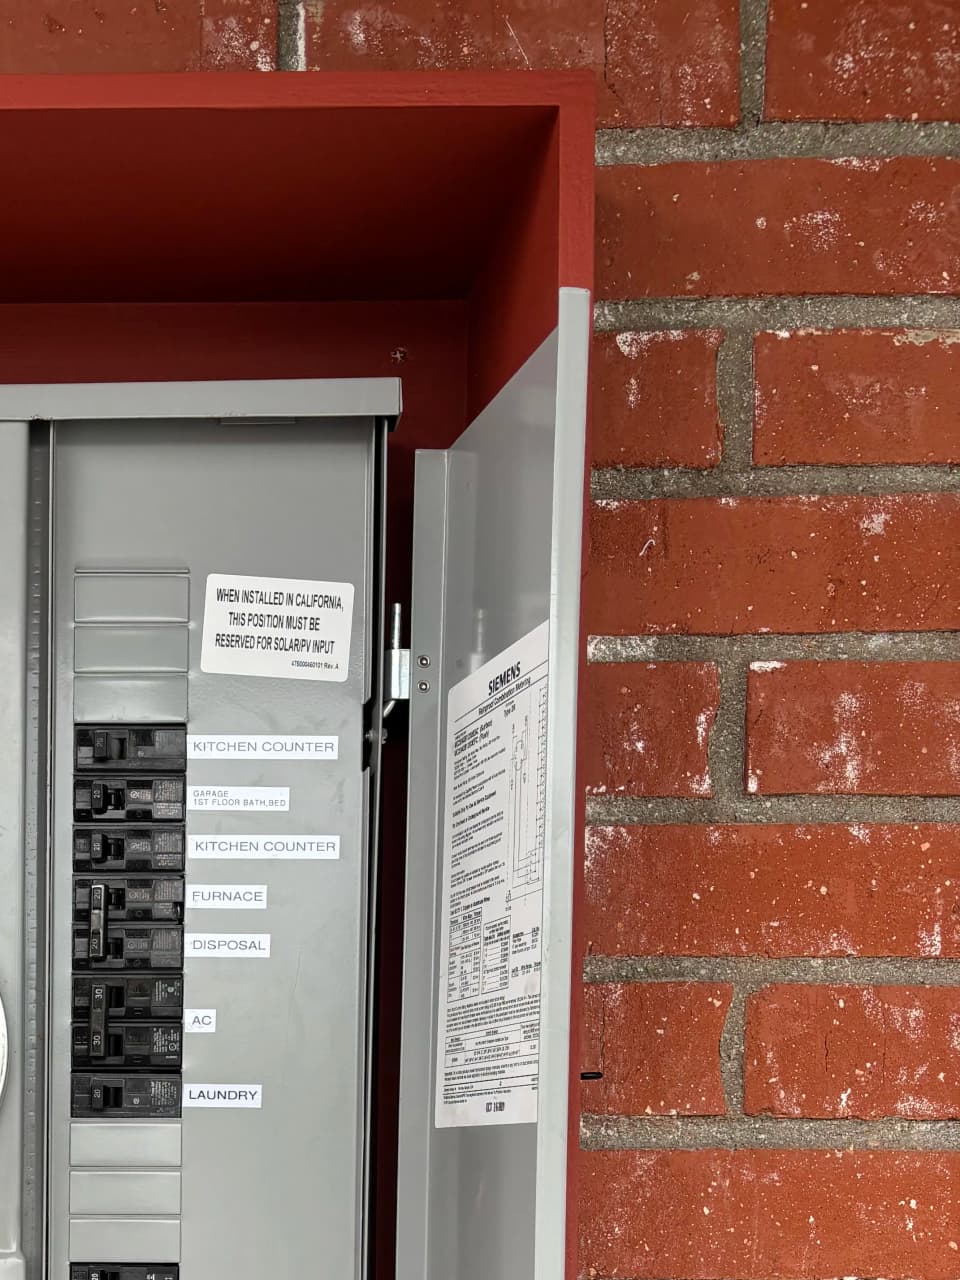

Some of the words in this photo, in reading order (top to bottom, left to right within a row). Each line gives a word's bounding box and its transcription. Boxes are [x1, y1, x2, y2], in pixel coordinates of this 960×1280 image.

[216, 588, 240, 603] WHEN
[241, 590, 284, 606] INSTALLED
[286, 593, 293, 606] IN
[295, 593, 343, 612] CALIFORNIA,
[229, 611, 245, 626] THIS
[247, 613, 283, 628] POSITION
[286, 616, 306, 630] MUST
[309, 617, 320, 631] BE
[215, 633, 255, 649] RESERVED
[256, 636, 272, 650] FOR
[274, 637, 311, 652] SOLAR/PV
[312, 640, 334, 654] INPUT
[488, 661, 521, 696] SIEMENS
[193, 741, 258, 752] KITCHEN
[261, 742, 335, 752] COUNTER
[193, 790, 229, 798] GARAGE
[193, 798, 209, 806] 1ST
[211, 798, 240, 806] FLOOR
[242, 799, 286, 808] BATH,BED
[195, 841, 258, 851] KITCHEN
[263, 841, 336, 852] COUNTER
[94, 889, 101, 899] 20
[192, 891, 263, 902] FURNACE
[91, 938, 98, 949] 20
[192, 940, 266, 951] DISPOSAL
[95, 989, 103, 999] 30
[191, 1015, 212, 1026] AC
[93, 1035, 101, 1045] 30
[94, 1089, 101, 1098] 20
[189, 1090, 258, 1101] LAUNDRY
